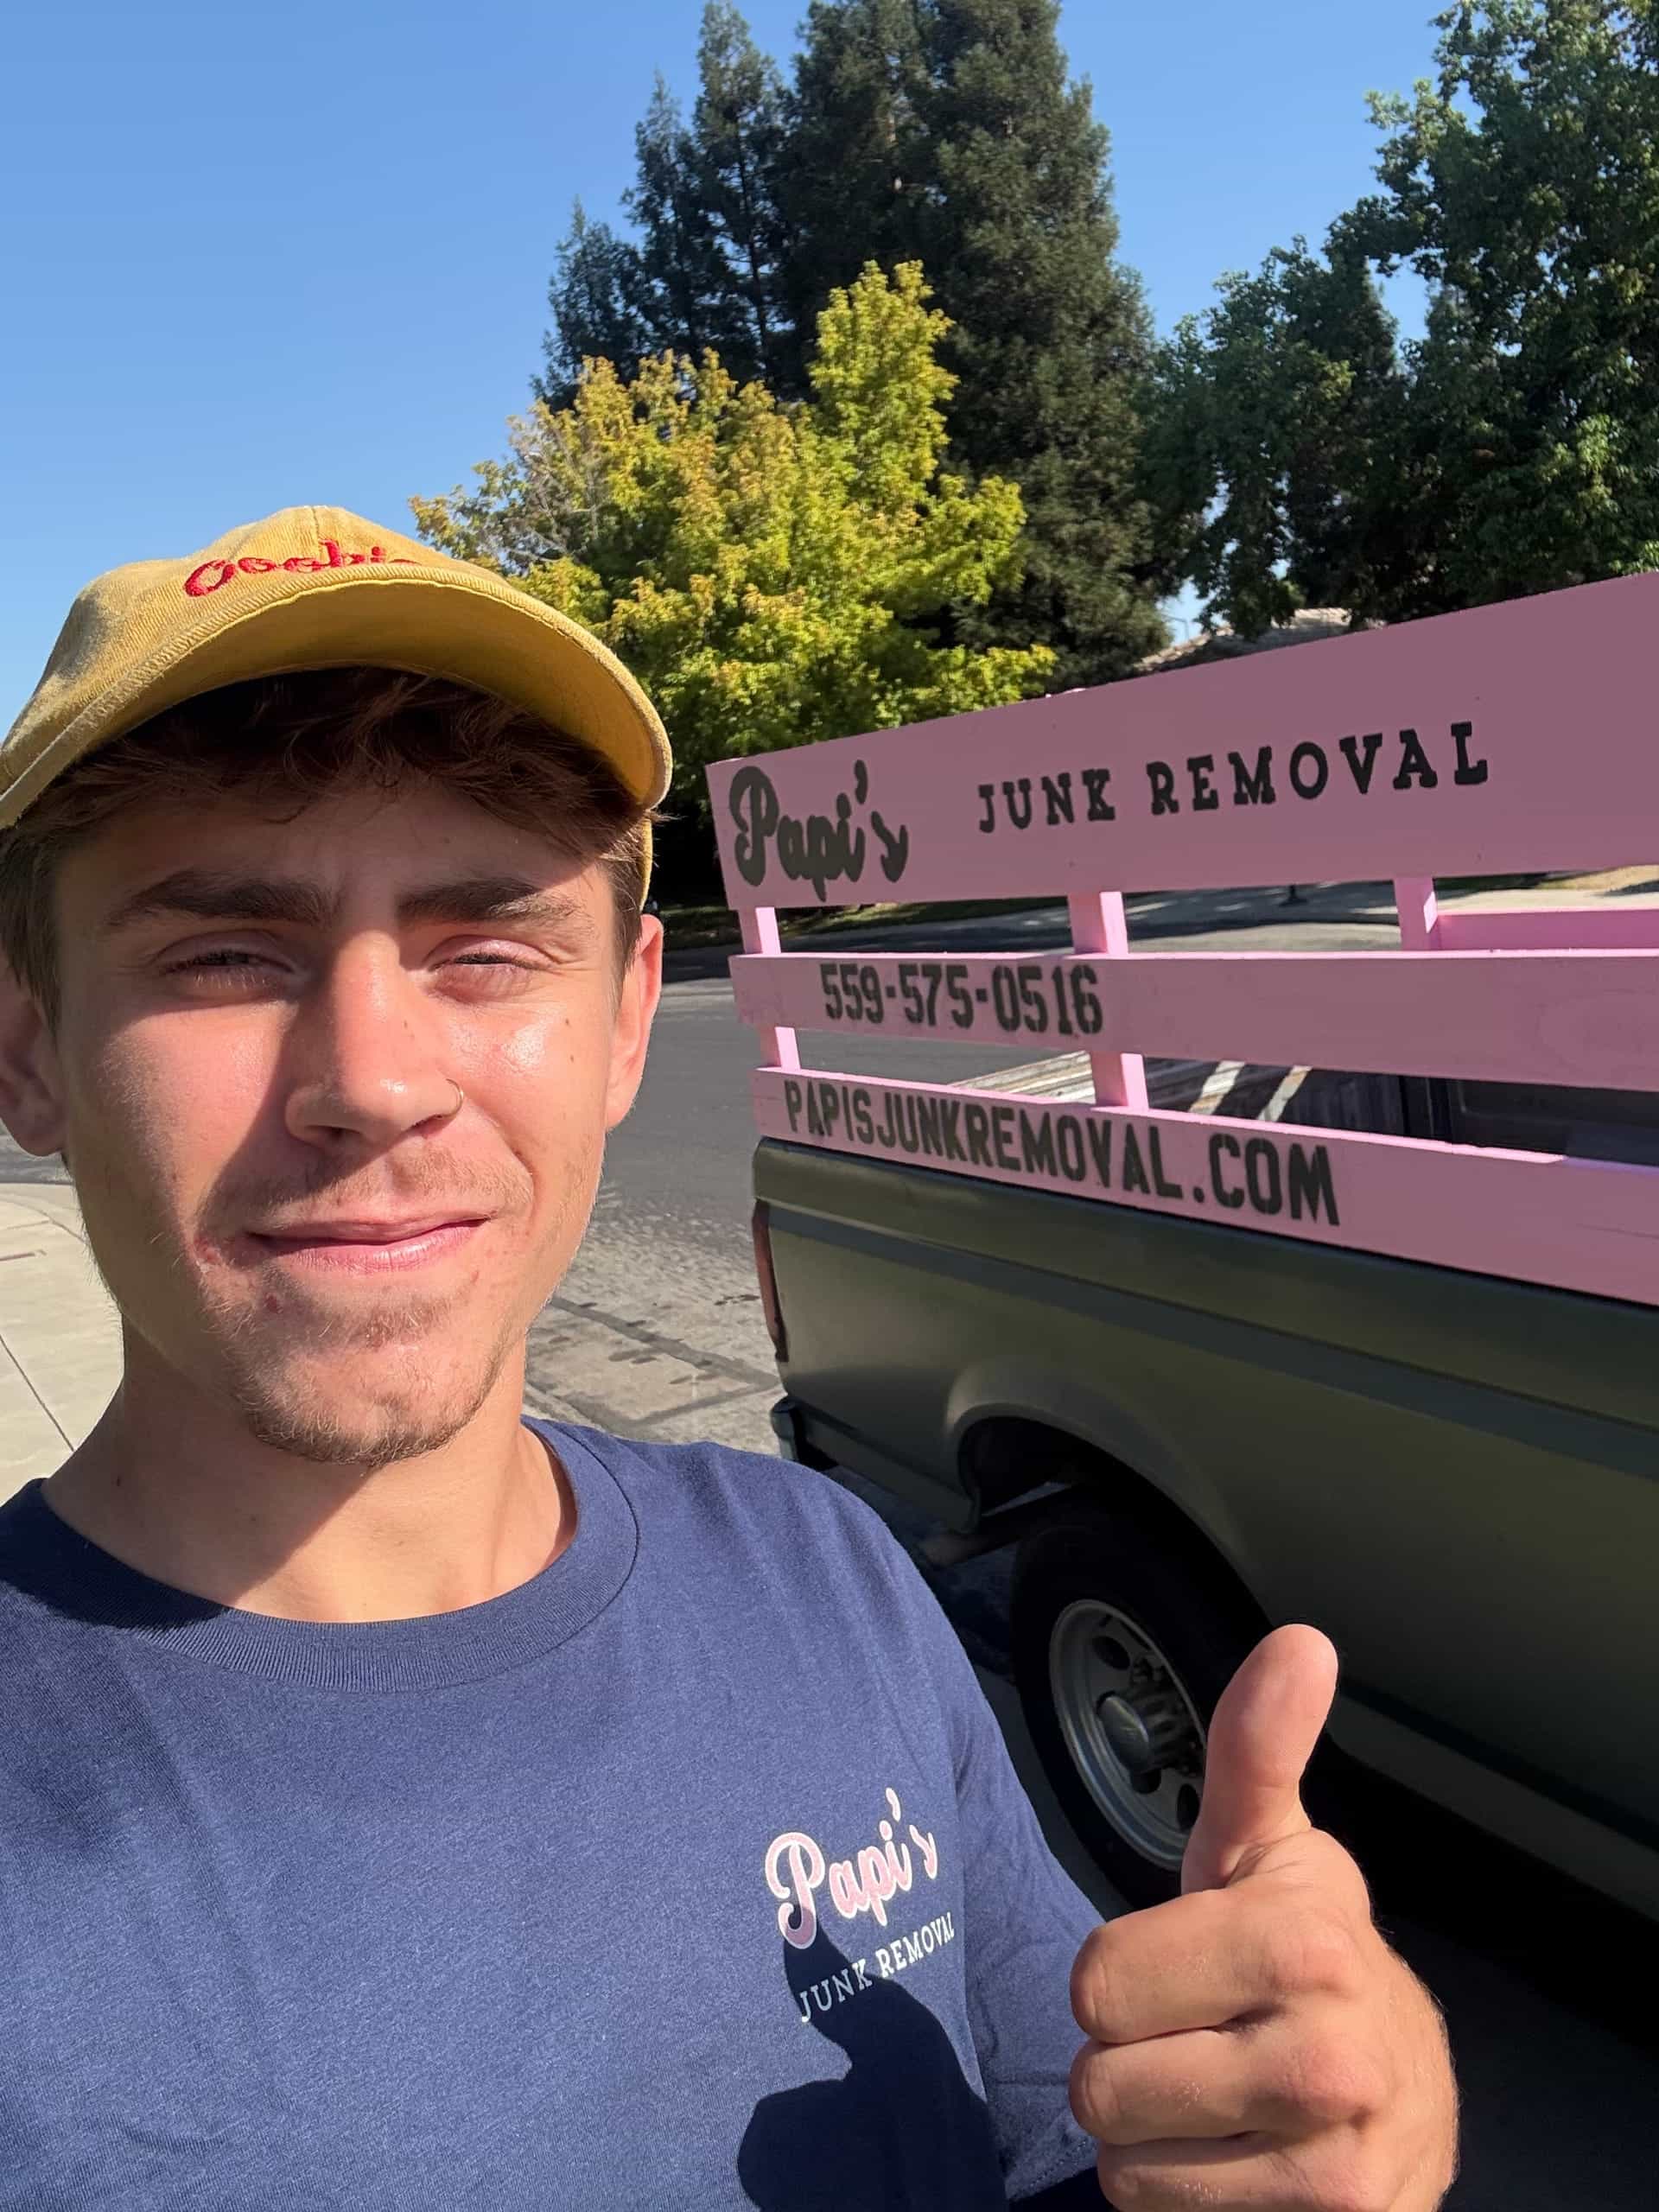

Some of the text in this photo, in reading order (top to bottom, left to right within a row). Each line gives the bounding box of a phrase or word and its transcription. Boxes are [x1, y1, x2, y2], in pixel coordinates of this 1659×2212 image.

[729, 721, 1488, 903] Papi's JUNK REMOVAL
[819, 963, 1104, 1036] 559-575-0516
[783, 1079, 1340, 1226] PAPISJUNKREMOVAL.COM
[765, 1787, 938, 1950] Papi's
[798, 1911, 955, 2023] JUNK REMOVAL
